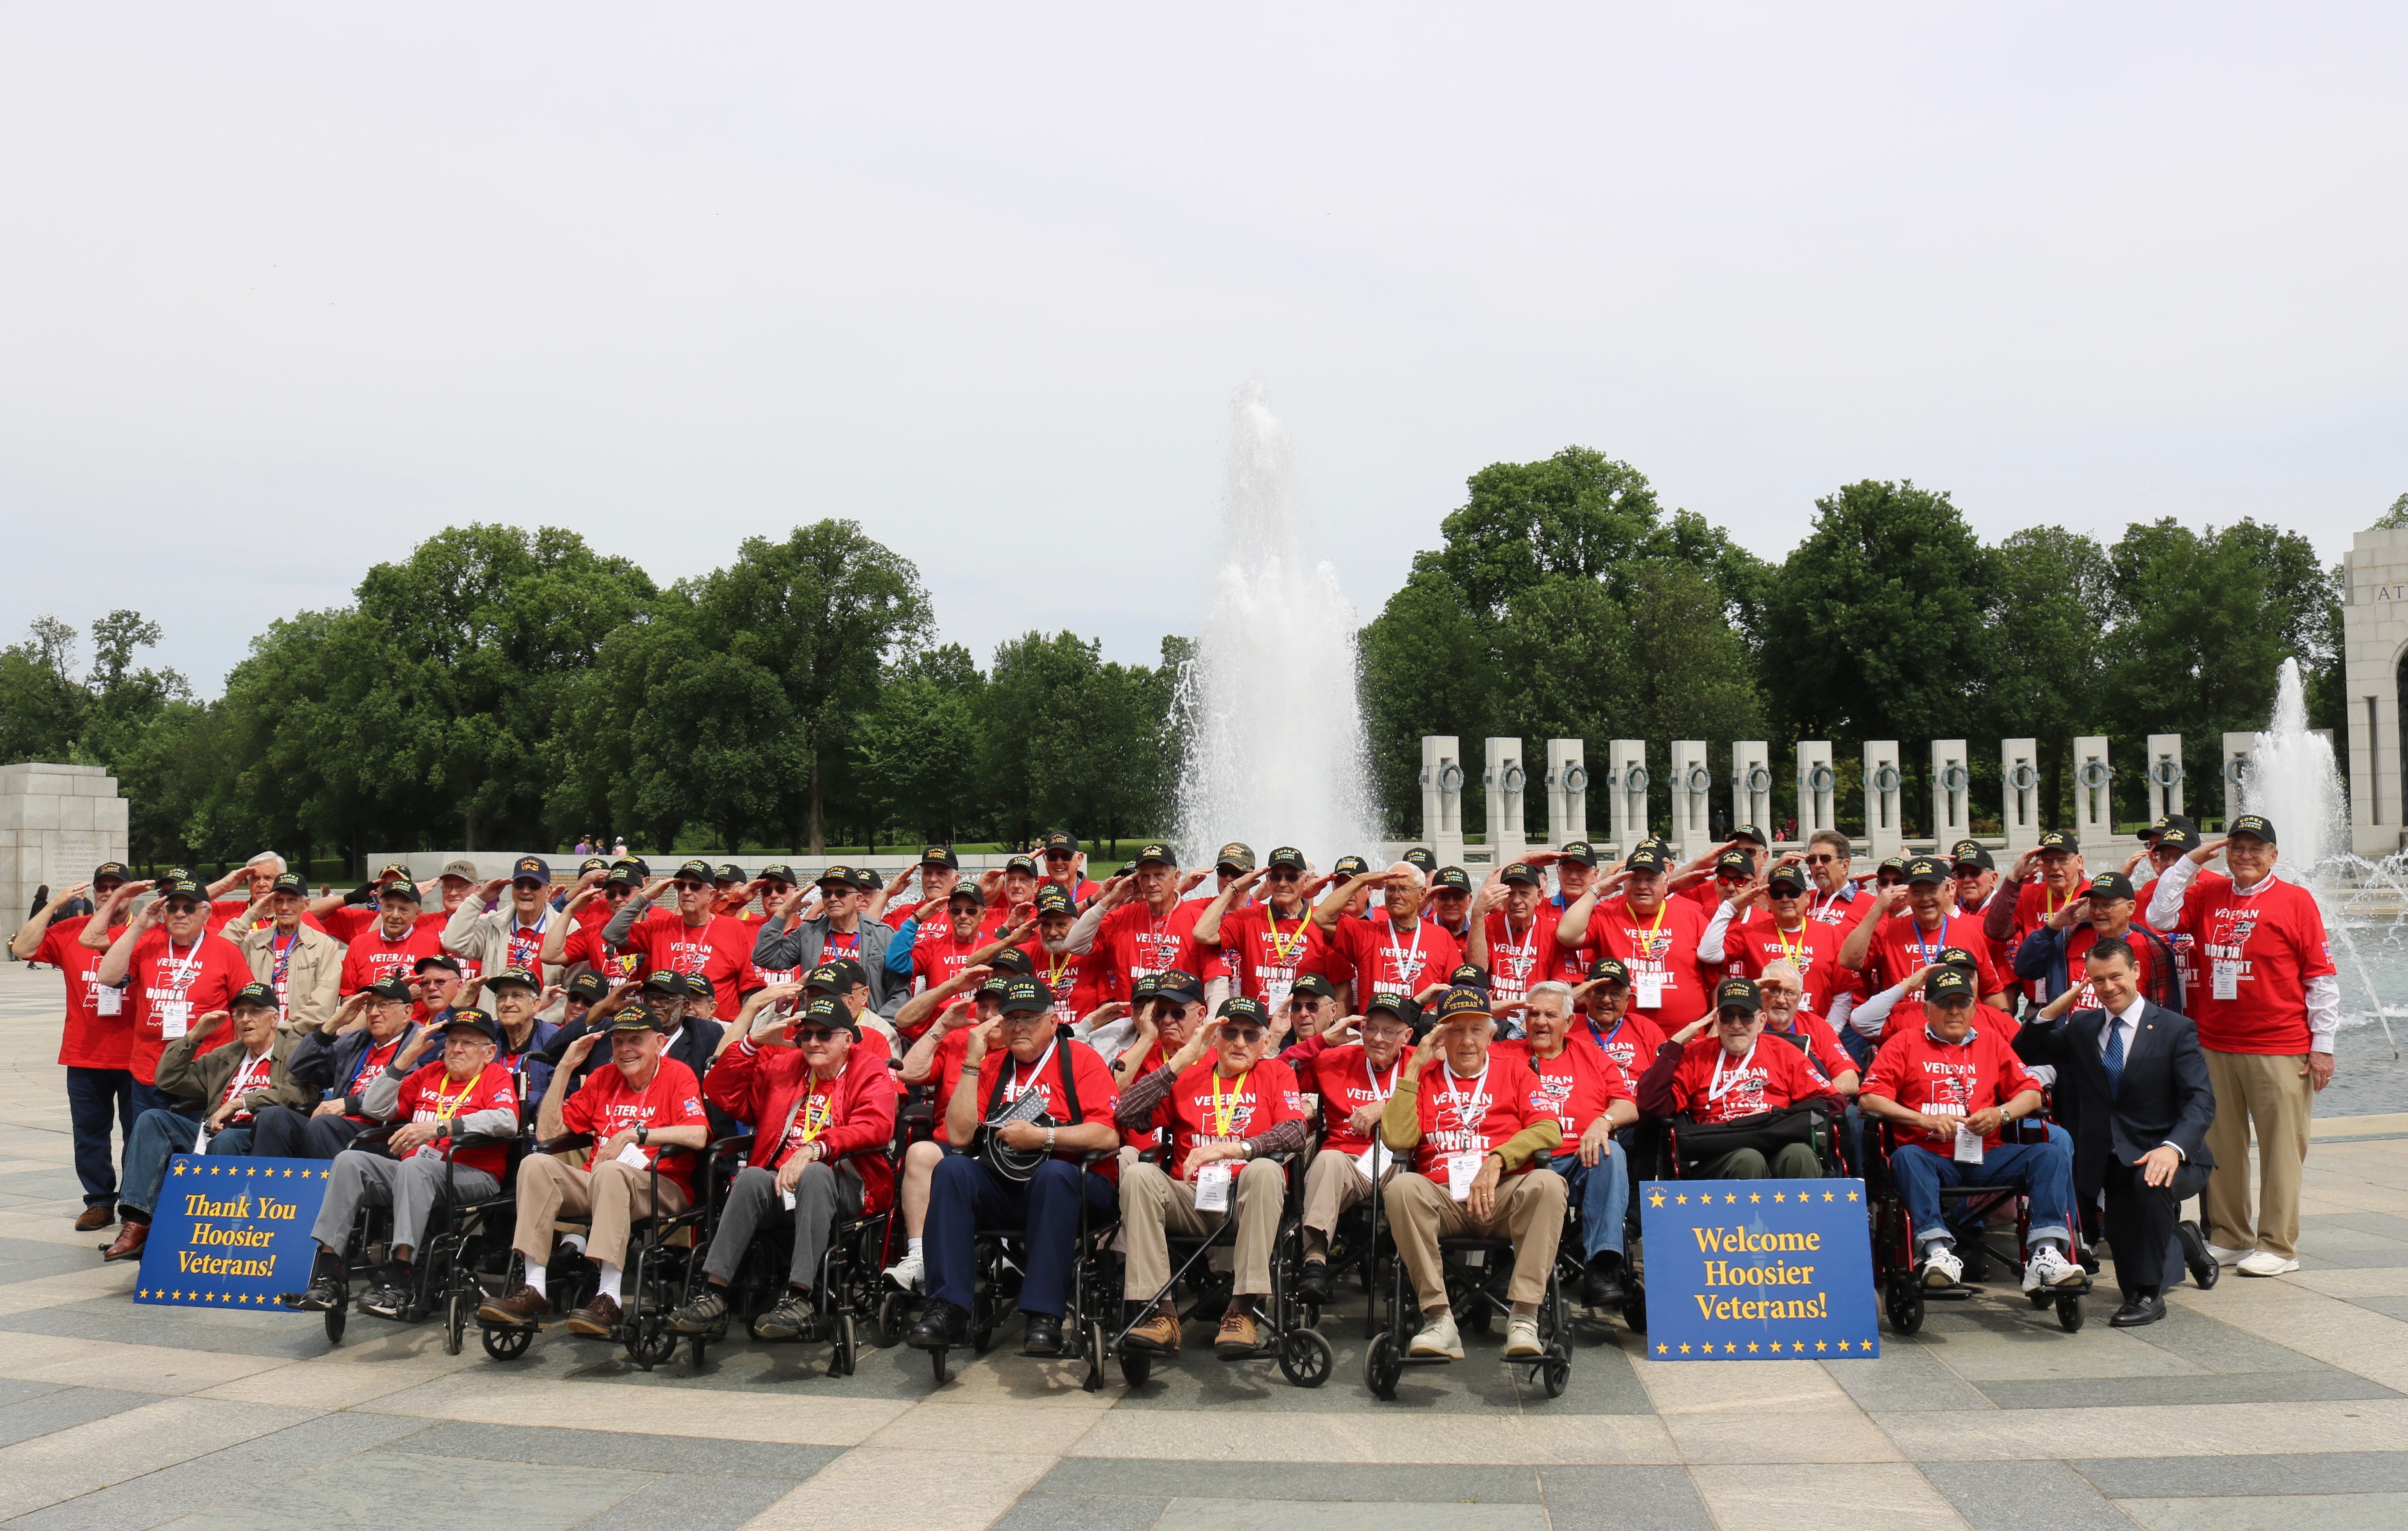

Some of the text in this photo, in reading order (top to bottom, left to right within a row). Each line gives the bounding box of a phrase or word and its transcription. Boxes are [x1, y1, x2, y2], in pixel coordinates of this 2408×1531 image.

[2239, 817, 2263, 825] KOREA
[447, 864, 470, 874] USMC
[1911, 862, 1921, 870] COLD
[2204, 944, 2240, 959] HONOR
[1613, 962, 1622, 970] WAR
[1623, 957, 1662, 971] HONOR
[826, 968, 837, 977] WAR
[1159, 972, 1187, 982] U.S. NAVY
[1255, 966, 1294, 979] HONOR
[1937, 973, 1949, 982] COLD
[579, 974, 599, 983] VIETNAM
[1939, 979, 1962, 987] VETERAN
[1009, 983, 1035, 992] KOREA
[1229, 997, 1256, 1007] KOREA
[1378, 993, 1401, 1004] KOREA
[1442, 989, 1484, 1010] WORLD WAR II
[810, 1000, 834, 1009] KOREA
[1450, 1000, 1477, 1009] VETERAN
[630, 1006, 643, 1014] WAR
[1921, 1102, 1967, 1116] HONOR
[184, 1194, 297, 1220] Thank You
[189, 1223, 275, 1247] Hoosier
[1692, 1225, 1820, 1253] Welcome
[178, 1251, 277, 1277] Veterans!
[1704, 1259, 1814, 1286] Hoosier
[1694, 1292, 1828, 1320] Veterans!
